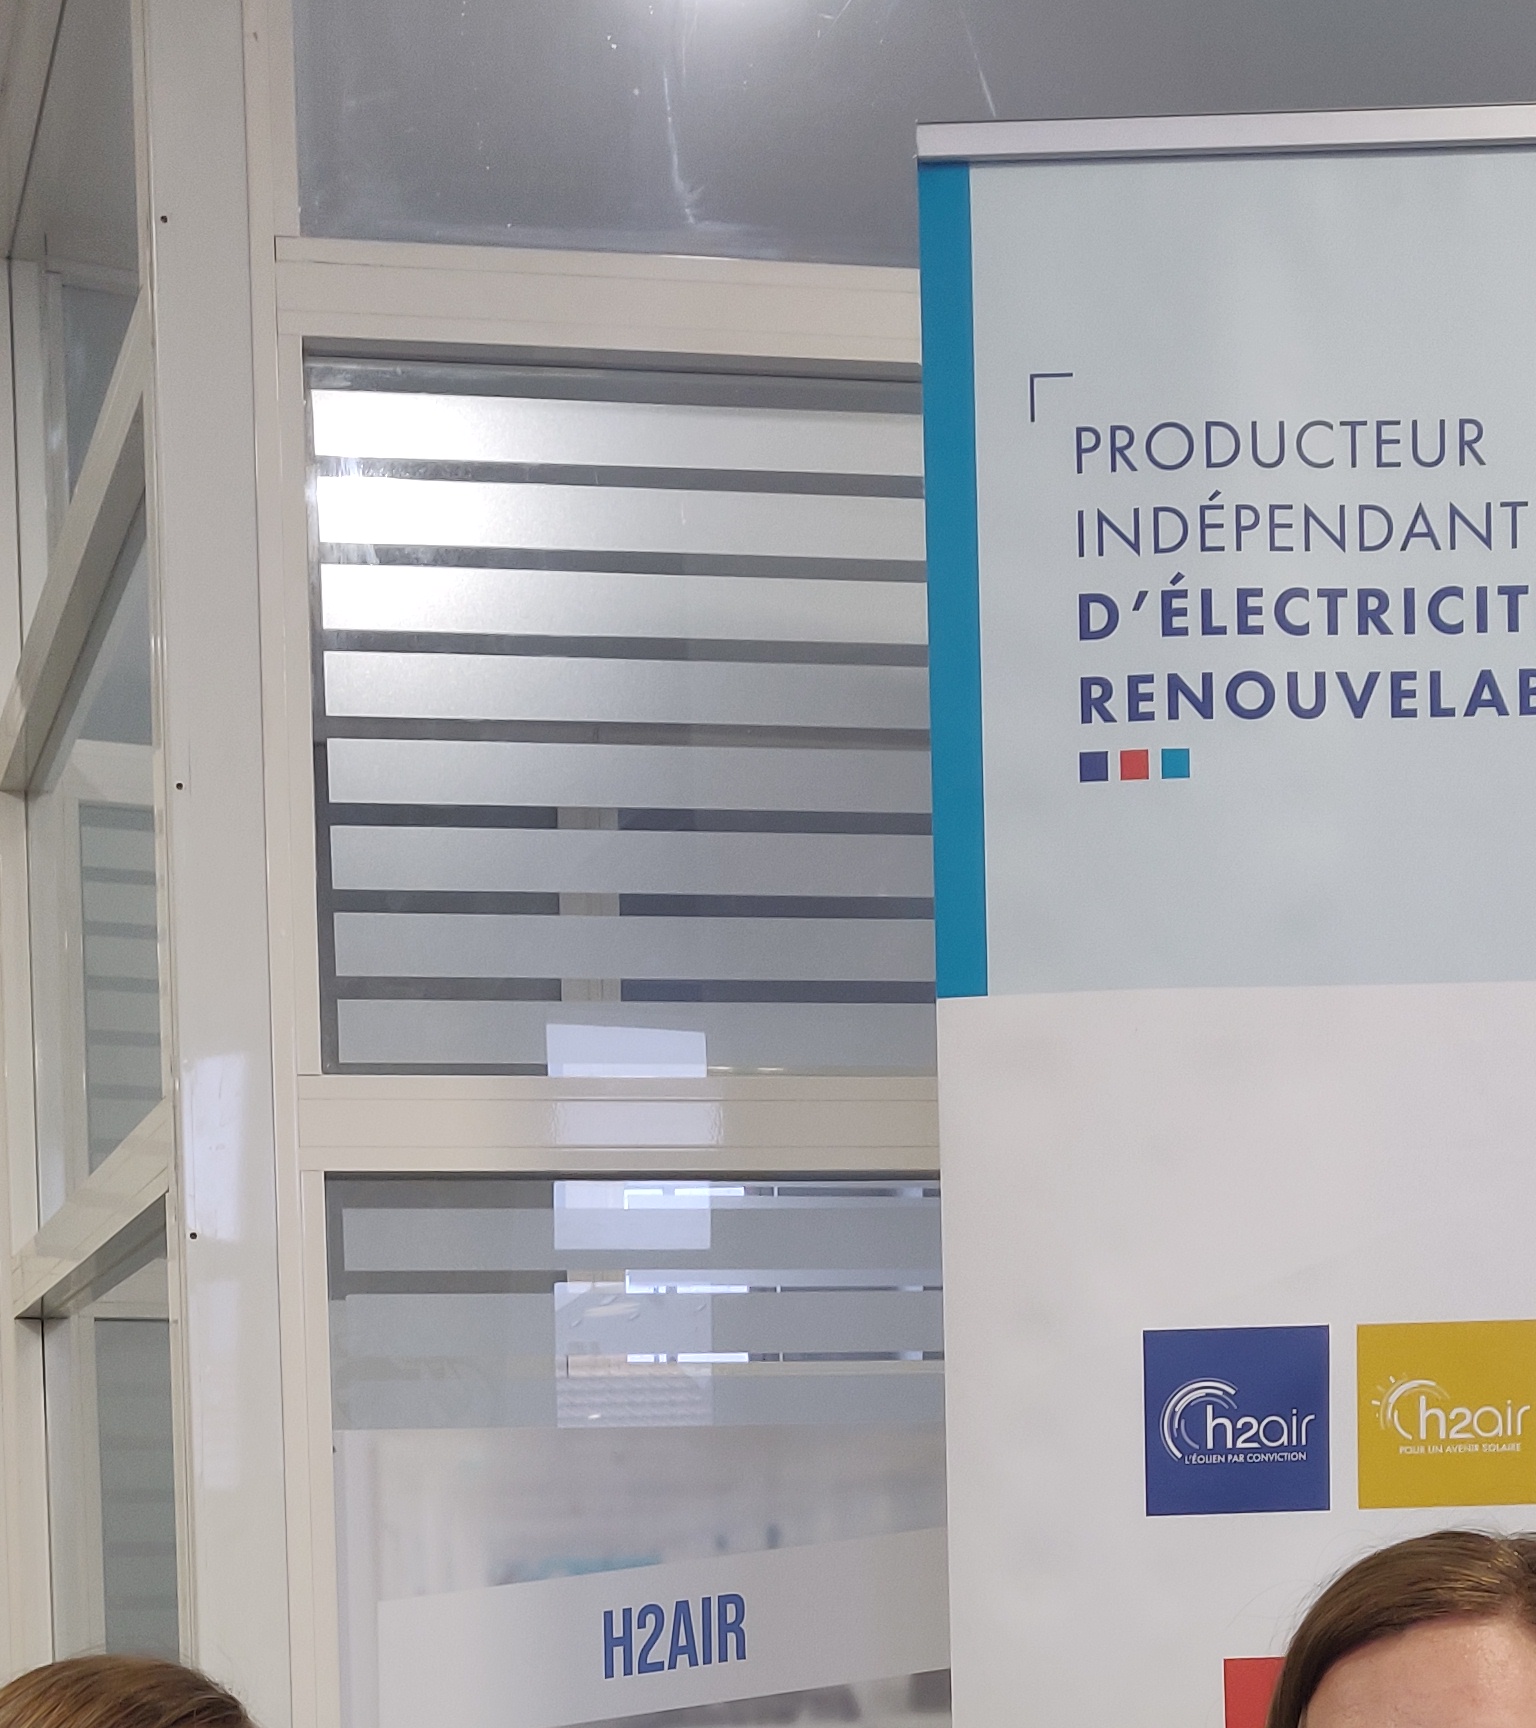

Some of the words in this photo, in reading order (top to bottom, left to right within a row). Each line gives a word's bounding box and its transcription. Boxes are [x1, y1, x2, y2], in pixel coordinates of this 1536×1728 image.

[1075, 418, 1486, 474] PRODUCTEUR
[1076, 489, 1529, 558] INDÉPENDANT
[1206, 1403, 1316, 1450] h2air
[1419, 1395, 1531, 1440] h2air
[1184, 1452, 1226, 1465] L'ÉOLIEN
[1227, 1452, 1245, 1464] PAR
[1246, 1451, 1307, 1463] CONVICTION
[1399, 1445, 1425, 1455] POUR
[1427, 1444, 1444, 1454] UN
[1445, 1442, 1480, 1454] AVENIR
[1481, 1441, 1522, 1453] SOLAIRE
[601, 1592, 748, 1681] H2AIR
